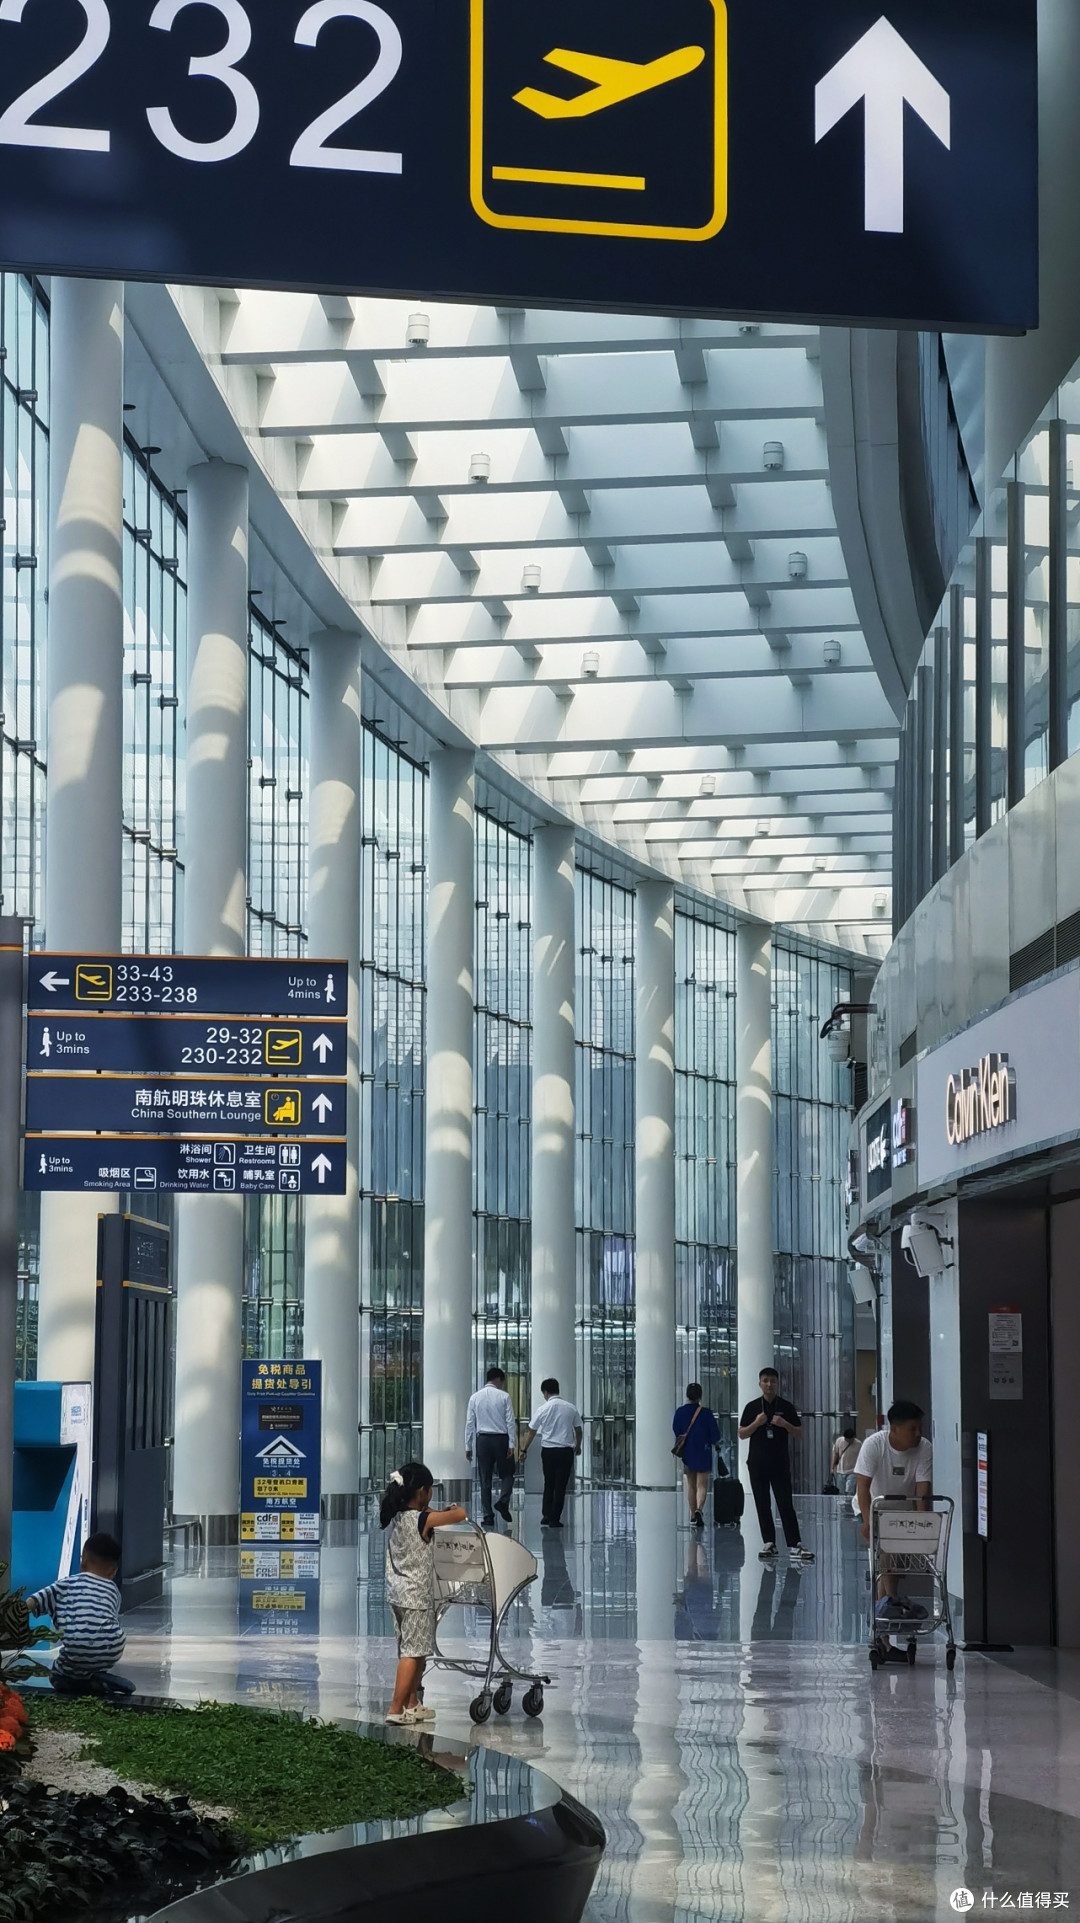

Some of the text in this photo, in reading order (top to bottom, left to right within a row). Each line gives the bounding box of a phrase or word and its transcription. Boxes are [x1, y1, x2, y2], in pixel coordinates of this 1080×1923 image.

[117, 965, 173, 982] 33-43
[288, 976, 317, 988] Up to
[116, 985, 198, 1003] 233-238
[288, 989, 321, 1000] 4mins
[56, 1031, 86, 1043] Up to
[206, 1028, 263, 1045] 29-32
[56, 1044, 90, 1054] 3mins
[181, 1047, 263, 1065] 230-232
[135, 1089, 261, 1108] 南航明珠休息室
[946, 1052, 1012, 1146] Calvin Klein
[131, 1108, 261, 1122] China Southern Lounge
[179, 1144, 212, 1155] 淋浴间
[244, 1144, 275, 1156] 卫生间
[49, 1157, 70, 1166] Up to
[48, 1165, 74, 1173] 3mins
[98, 1168, 131, 1179] 吸烟区
[177, 1168, 210, 1179] 饮用水
[243, 1169, 275, 1181] 哺乳室
[83, 1180, 131, 1188] Smoking Area
[159, 1181, 210, 1189] Drinking Water
[240, 1182, 275, 1190] Baby Care
[258, 1364, 306, 1375] 免税商品
[251, 1378, 312, 1390] 提货处导引
